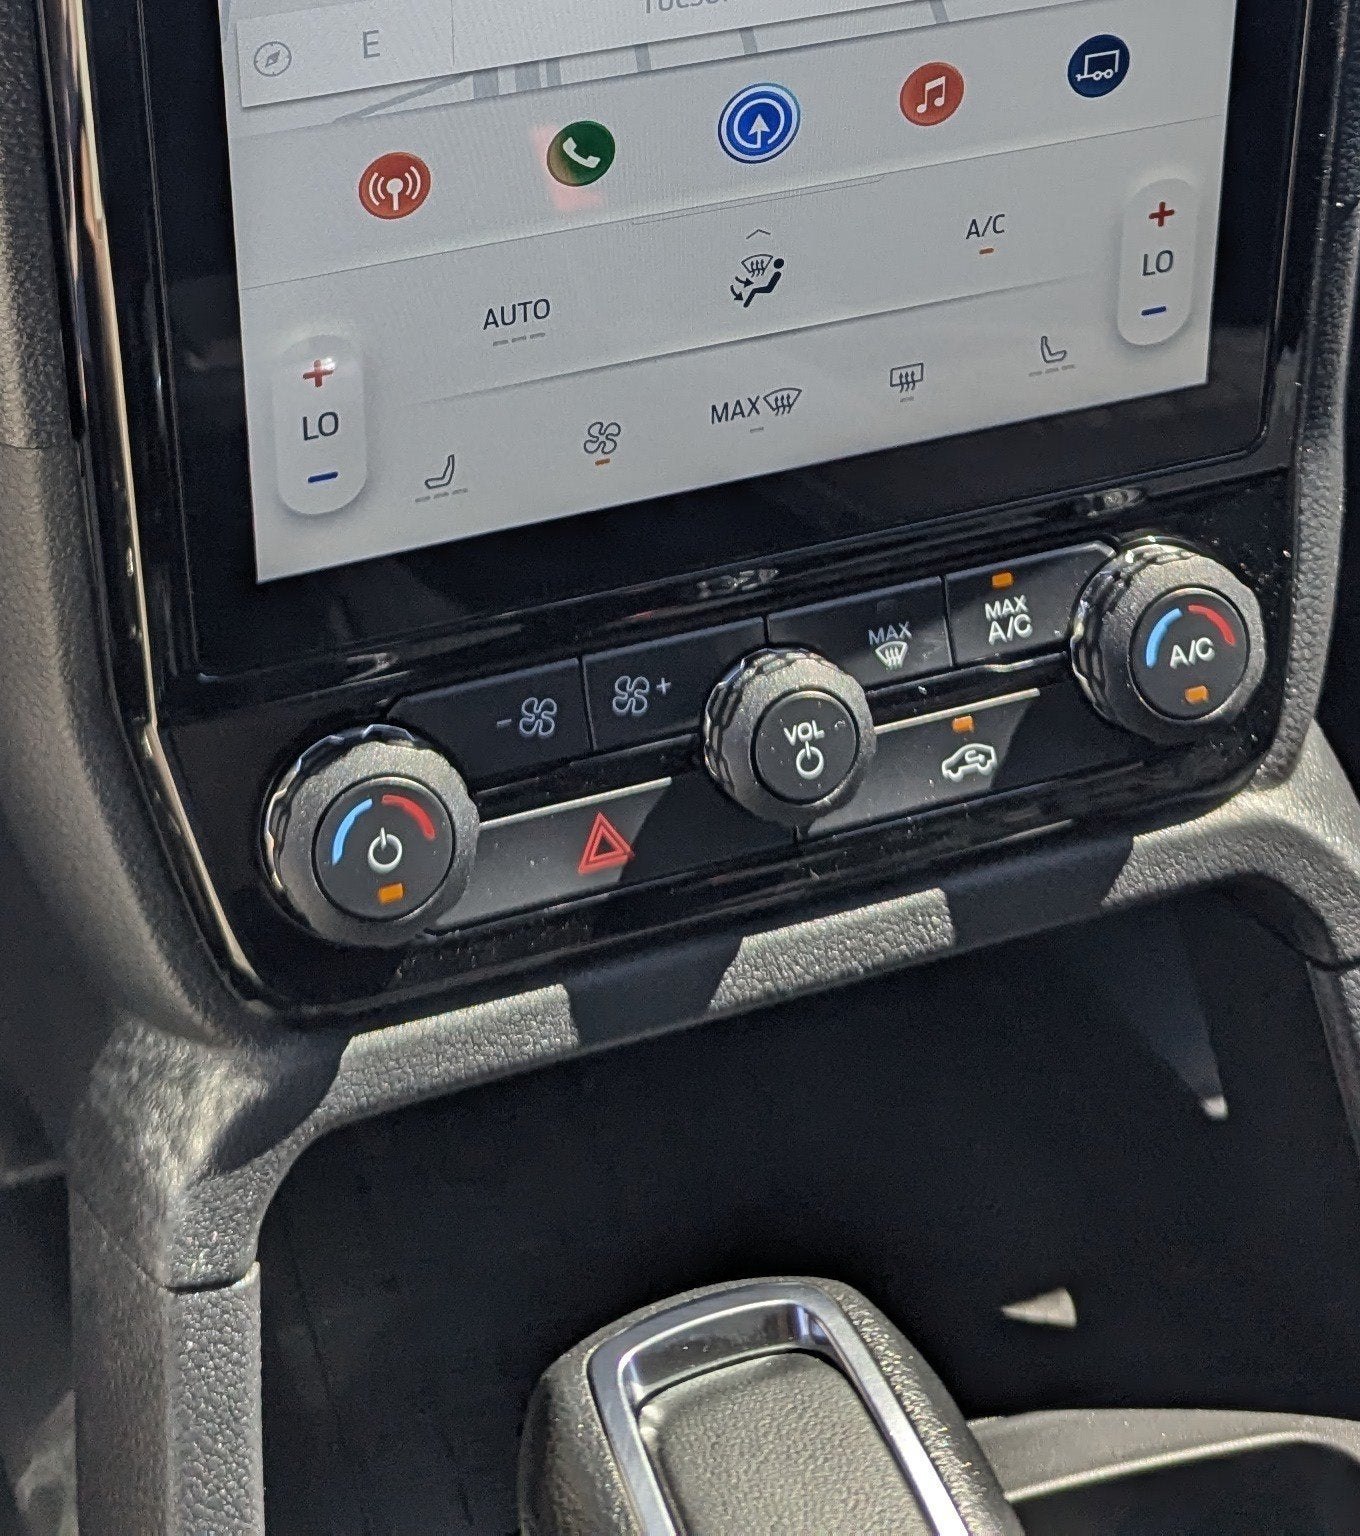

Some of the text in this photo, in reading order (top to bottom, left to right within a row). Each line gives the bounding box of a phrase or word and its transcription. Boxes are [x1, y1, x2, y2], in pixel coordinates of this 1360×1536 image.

[363, 29, 380, 59] E
[966, 213, 1005, 240] A/C
[1142, 249, 1174, 277] LO
[483, 297, 551, 332] AUTO
[710, 395, 761, 425] MAX
[302, 410, 339, 441] LO
[984, 595, 1028, 623] MAX
[868, 621, 912, 647] MAX
[988, 614, 1033, 646] A/C
[1170, 637, 1216, 671] A/C
[783, 719, 826, 747] VOL
